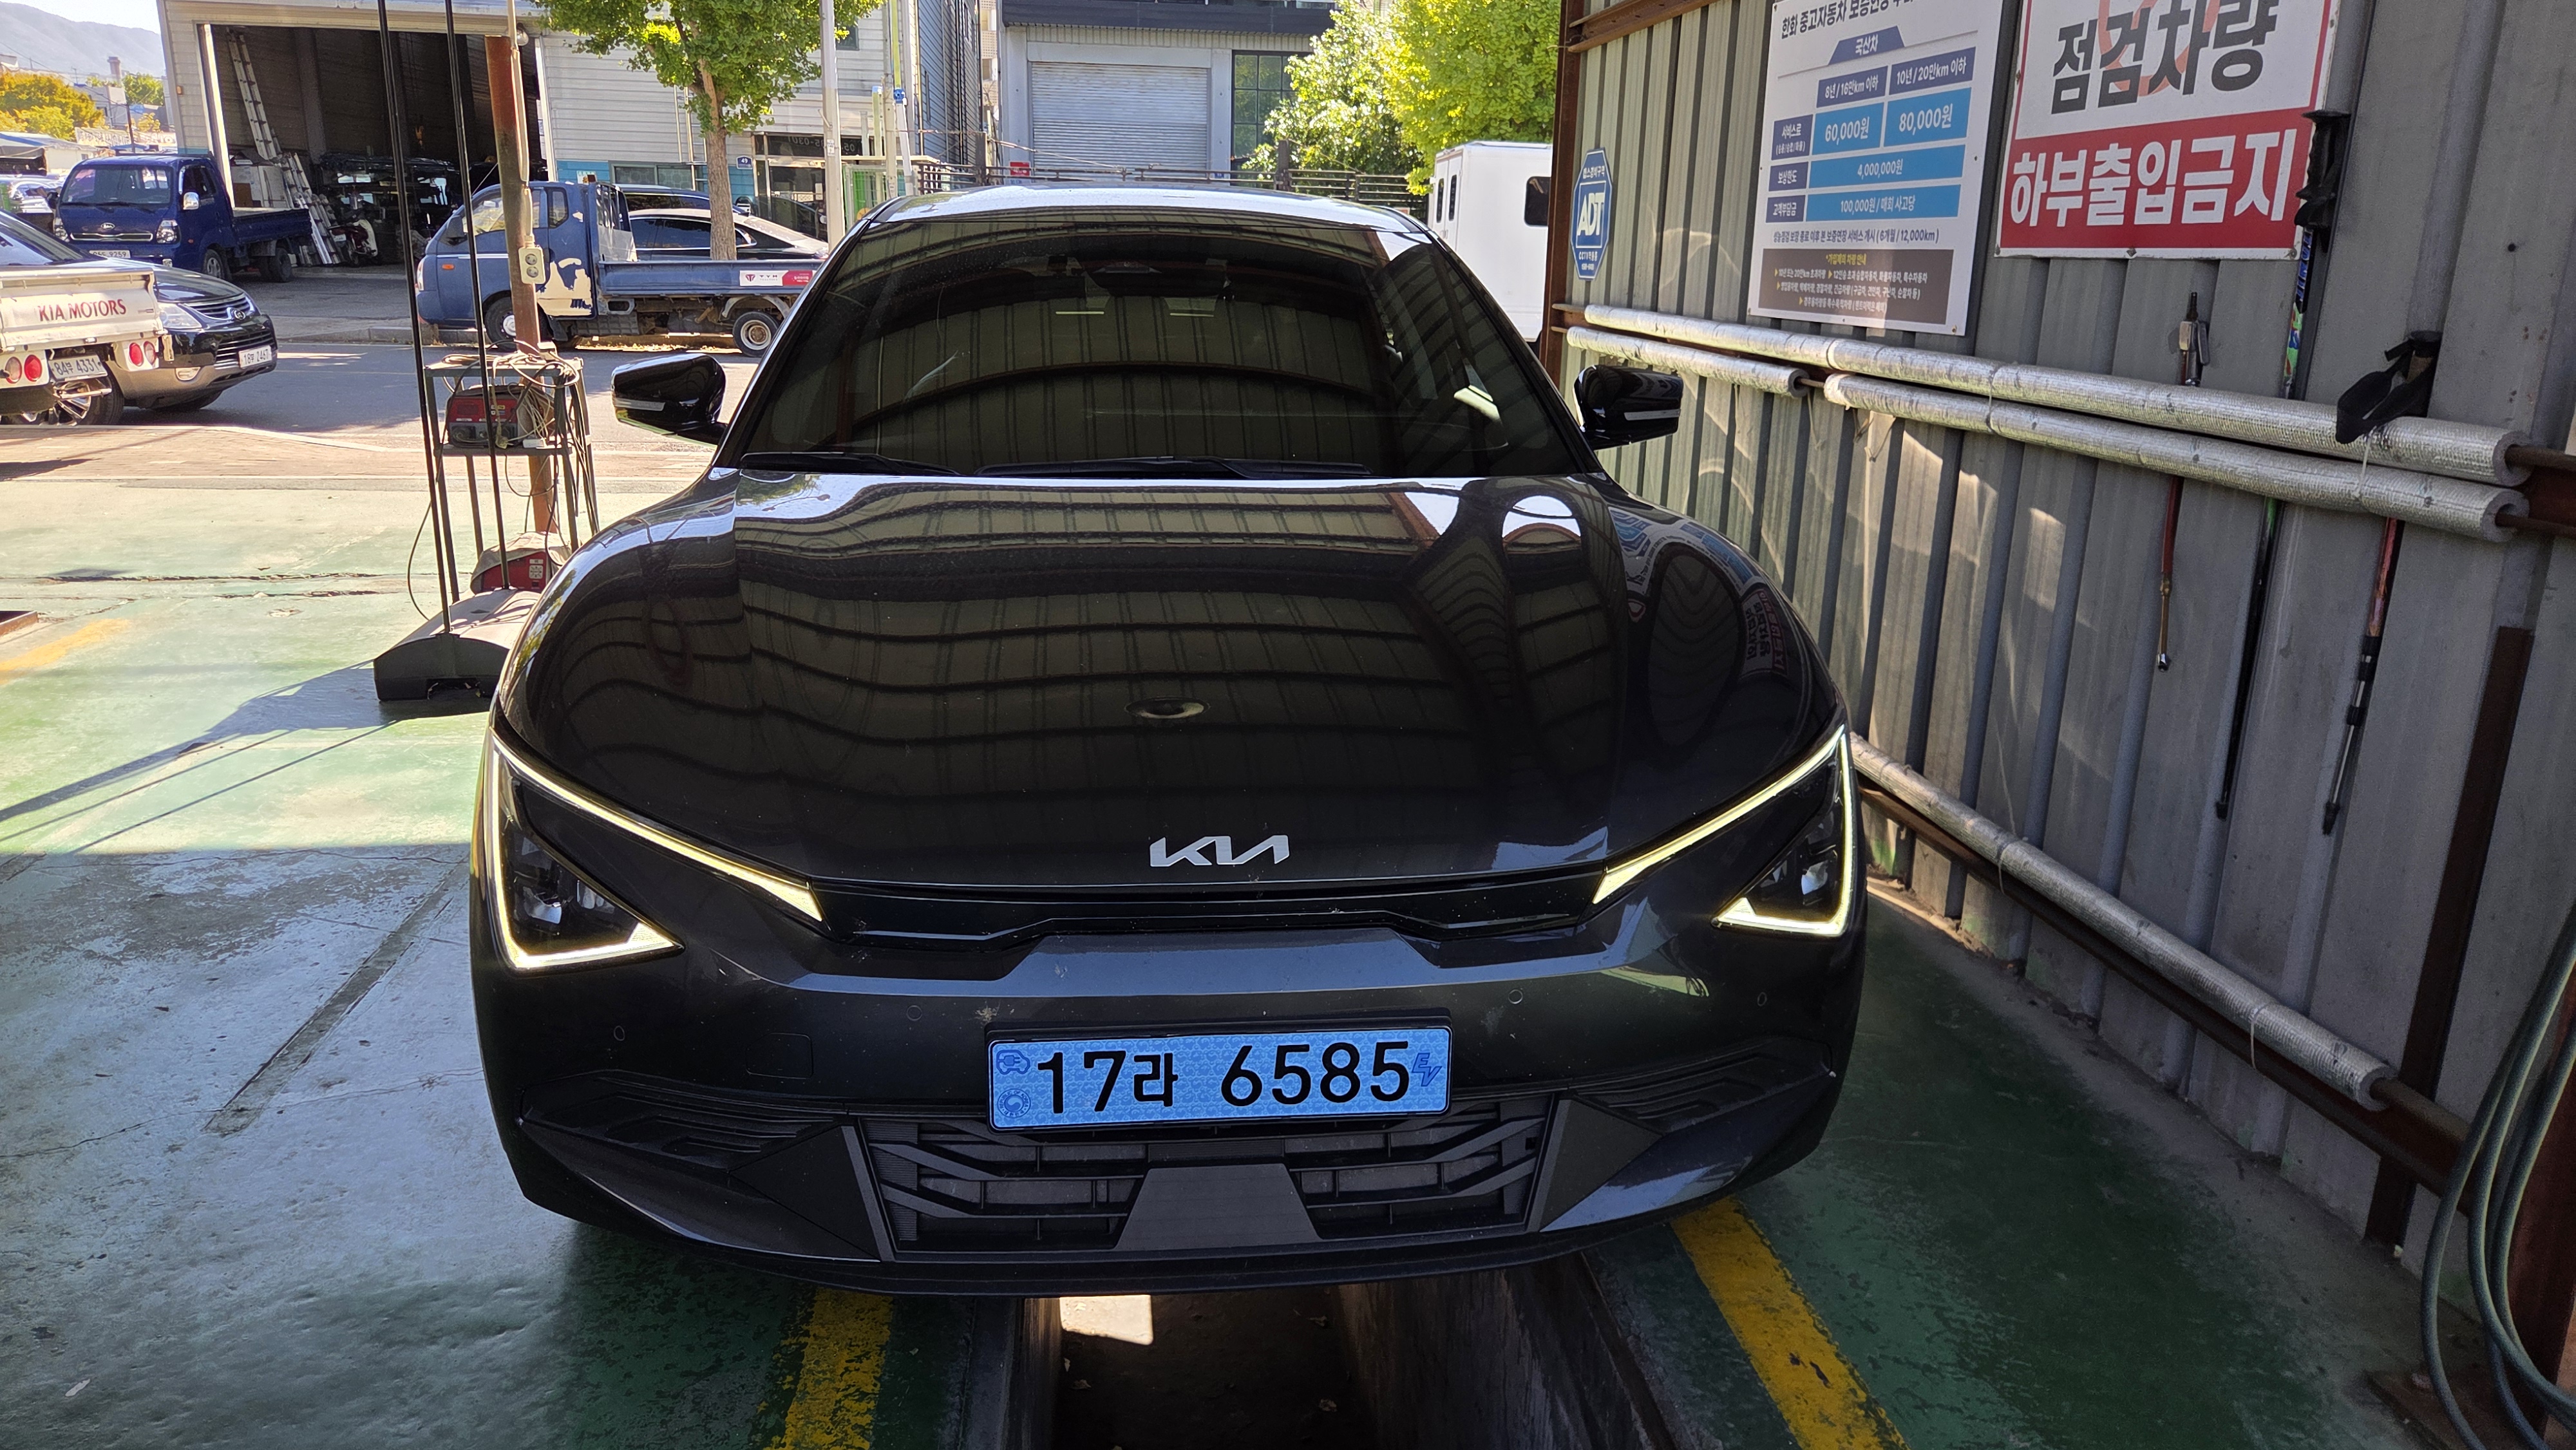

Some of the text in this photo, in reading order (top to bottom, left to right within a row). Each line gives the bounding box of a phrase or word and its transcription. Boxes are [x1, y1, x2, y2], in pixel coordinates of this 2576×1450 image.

[1781, 17, 1797, 39] 한화
[1800, 0, 1847, 32] 중고자동차
[1855, 34, 1879, 55] 국산차
[2051, 0, 2280, 115] 점검차량
[1951, 56, 1967, 76] 이하
[1866, 74, 1879, 92] 이하
[1824, 117, 1870, 146] 60,000원
[1899, 103, 1953, 136] 80,000원
[1857, 158, 1904, 180] 4,000,000원
[2010, 129, 2297, 227] 하부출입금지
[1577, 192, 1605, 236] ADT
[1841, 197, 1876, 216] 100,000원
[1895, 195, 1916, 212] 사고당
[38, 299, 127, 322] KIA MOTORS
[75, 357, 100, 373] 4331
[1150, 835, 1289, 867] KIA
[1037, 1040, 1410, 1114] 17라 6585
[1411, 1052, 1443, 1087] EV
